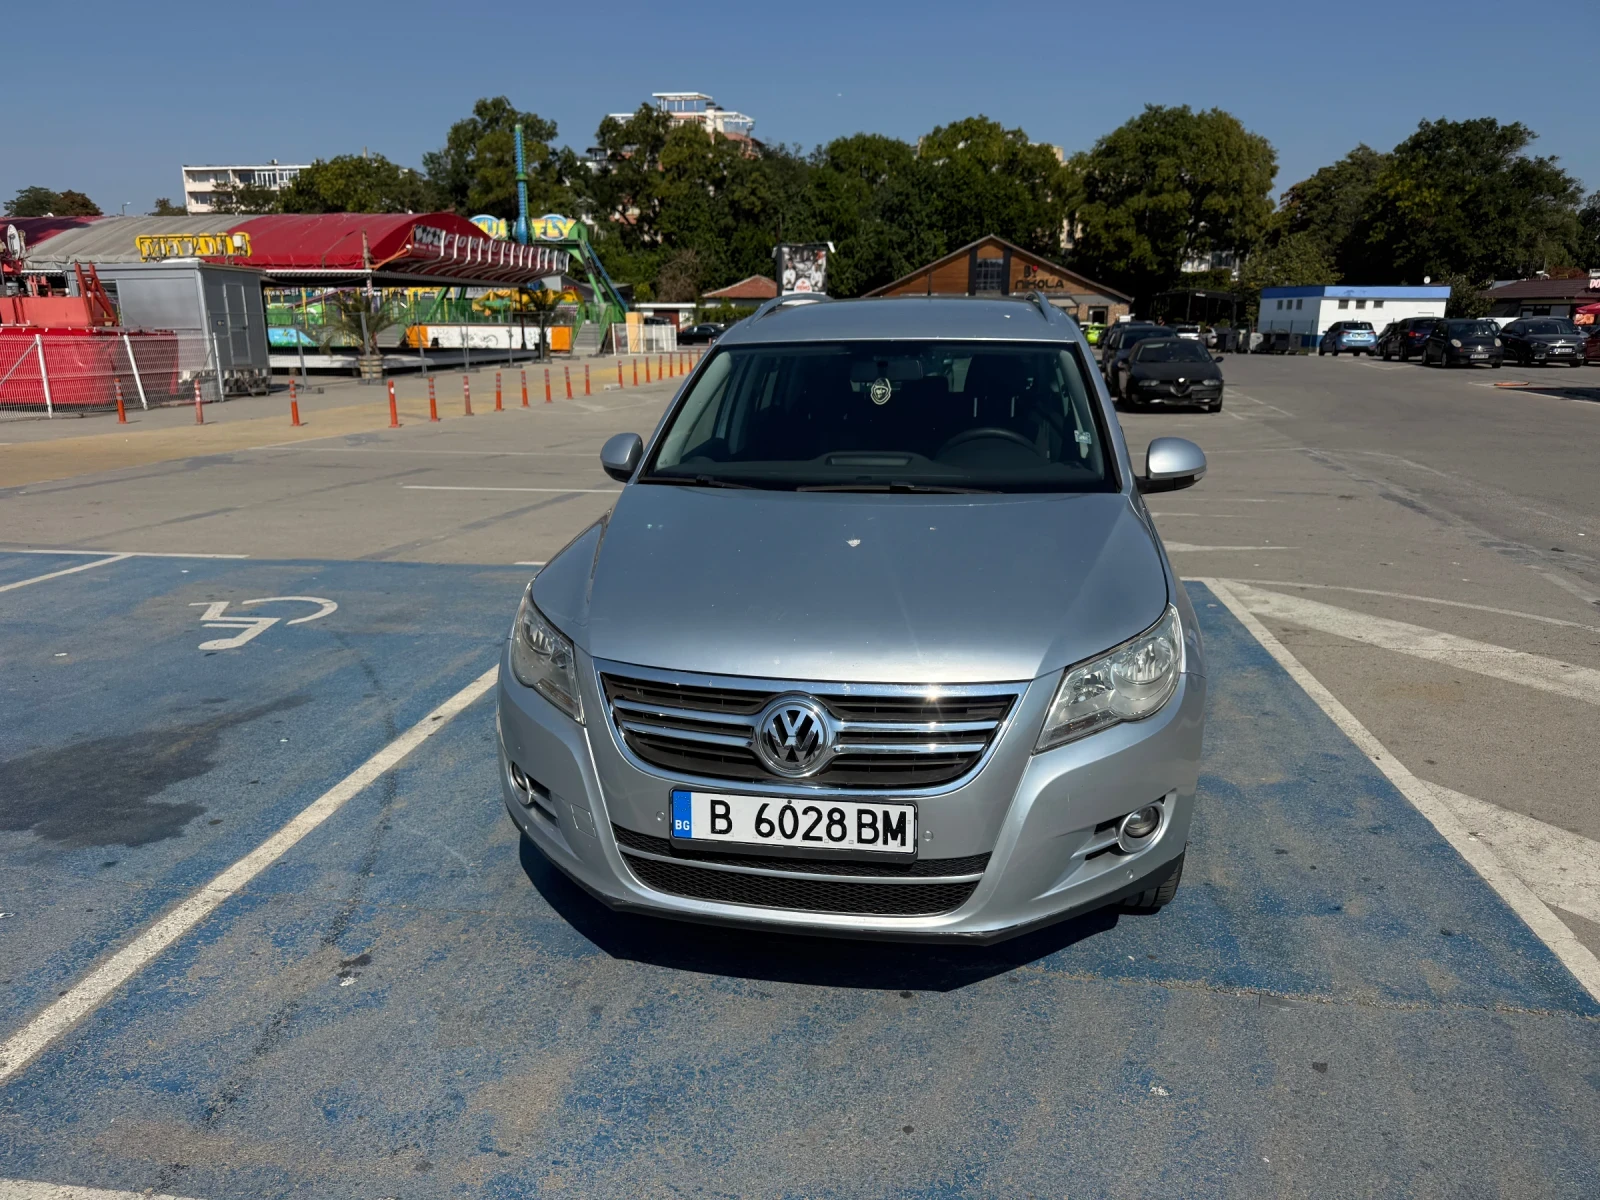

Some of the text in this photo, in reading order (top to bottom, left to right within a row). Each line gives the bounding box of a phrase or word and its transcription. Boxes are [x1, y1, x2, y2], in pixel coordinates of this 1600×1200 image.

[532, 218, 577, 239] FLY
[675, 820, 690, 831] BG
[709, 799, 907, 847] B 6028 BM
